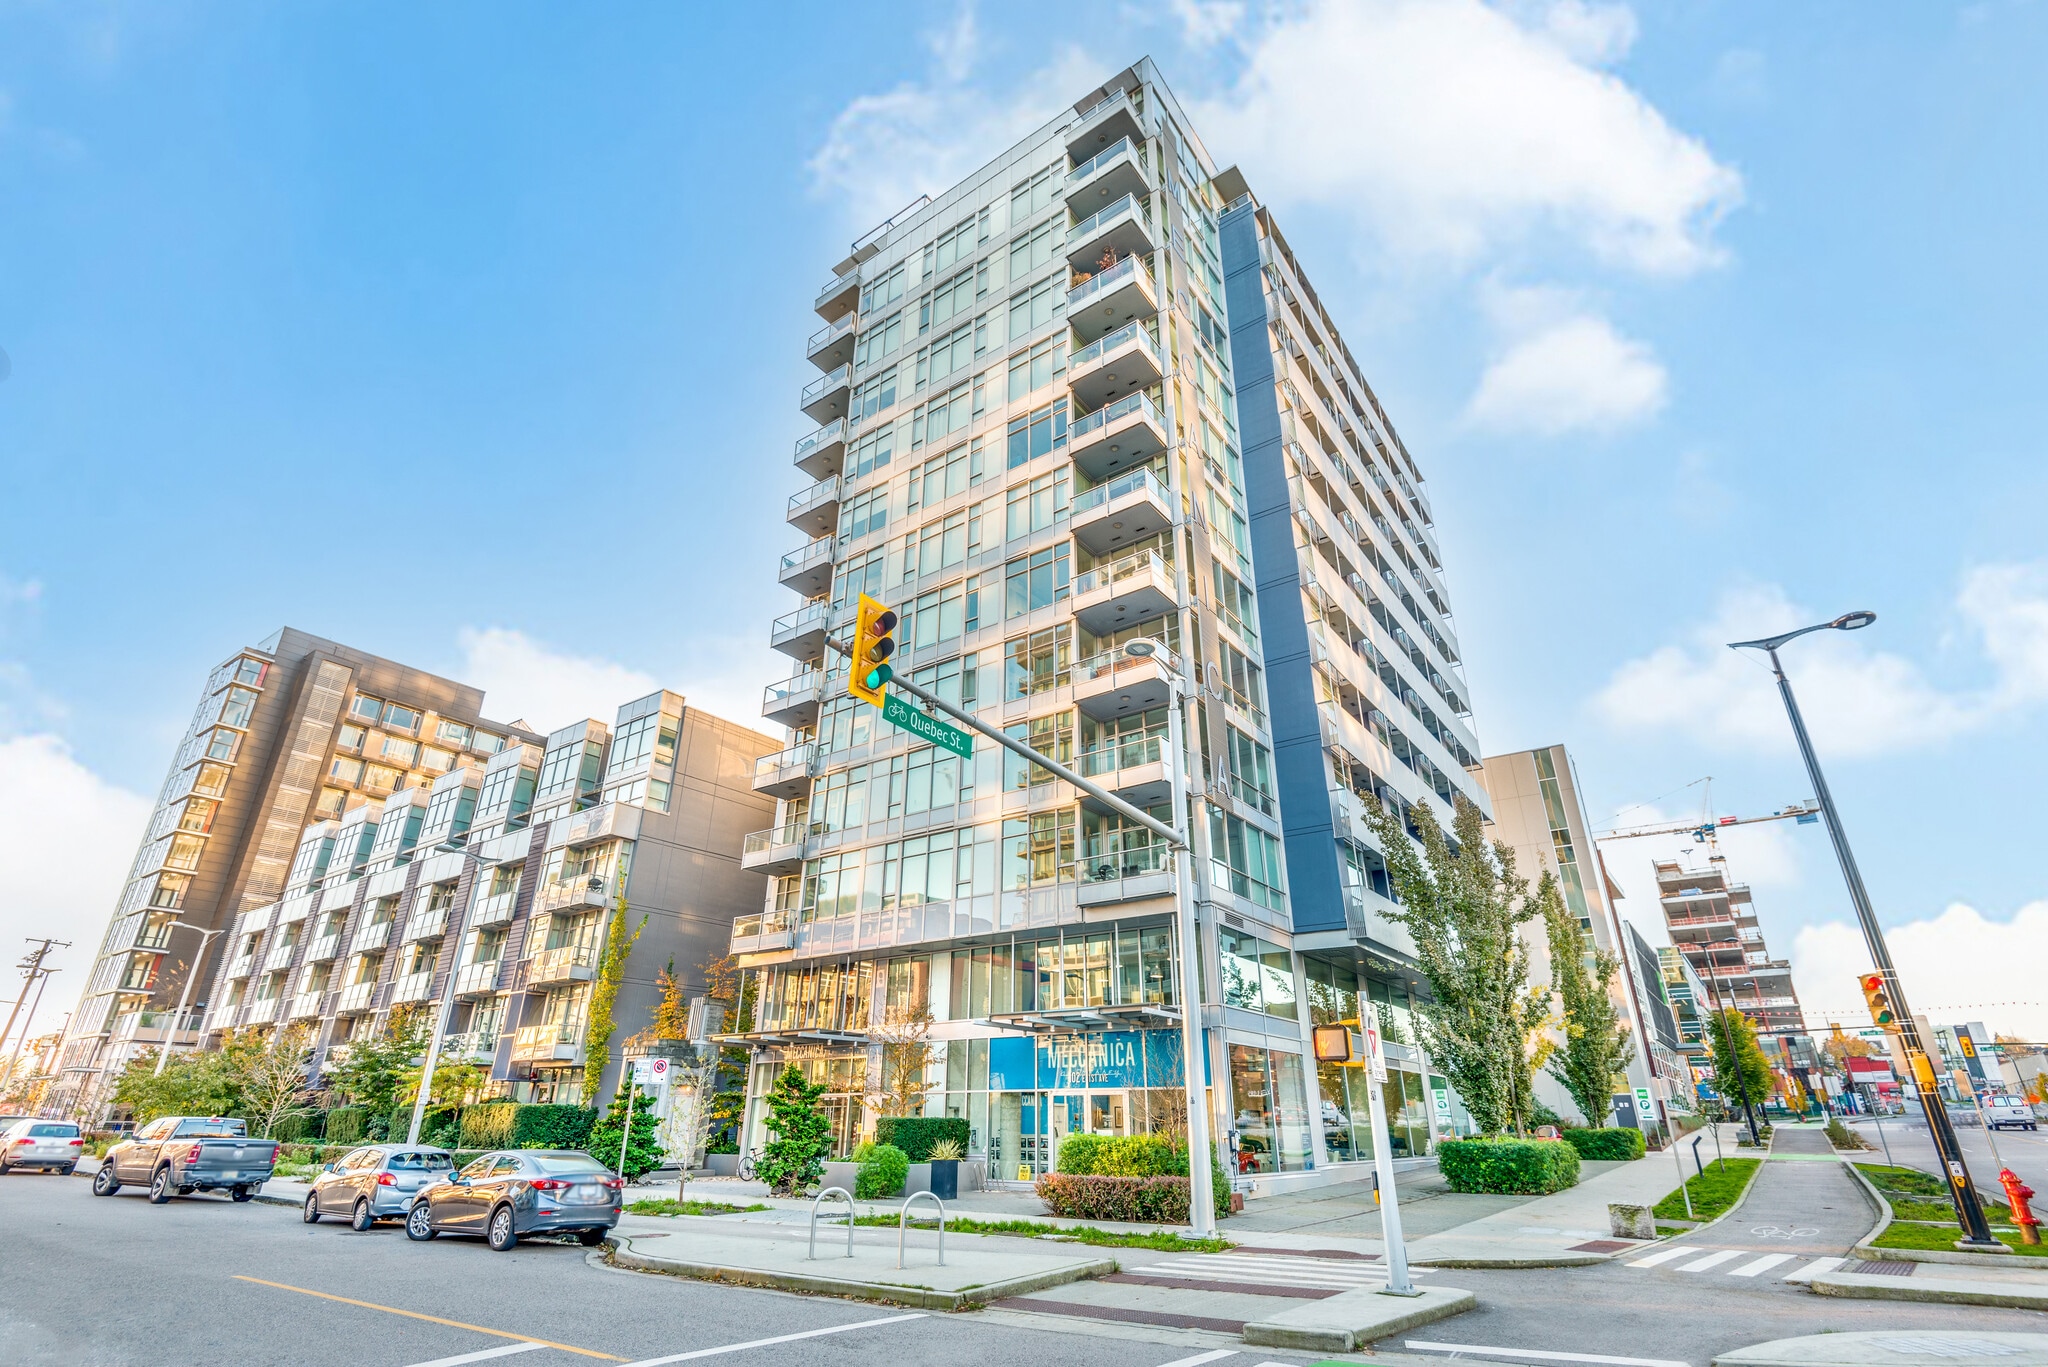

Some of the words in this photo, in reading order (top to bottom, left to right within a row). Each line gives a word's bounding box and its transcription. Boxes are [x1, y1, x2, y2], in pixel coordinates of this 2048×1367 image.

[1167, 167, 1232, 799] MECCANICA
[910, 711, 948, 743] Quebec
[950, 731, 964, 750] St.
[1048, 1043, 1135, 1068] MECCANICA
